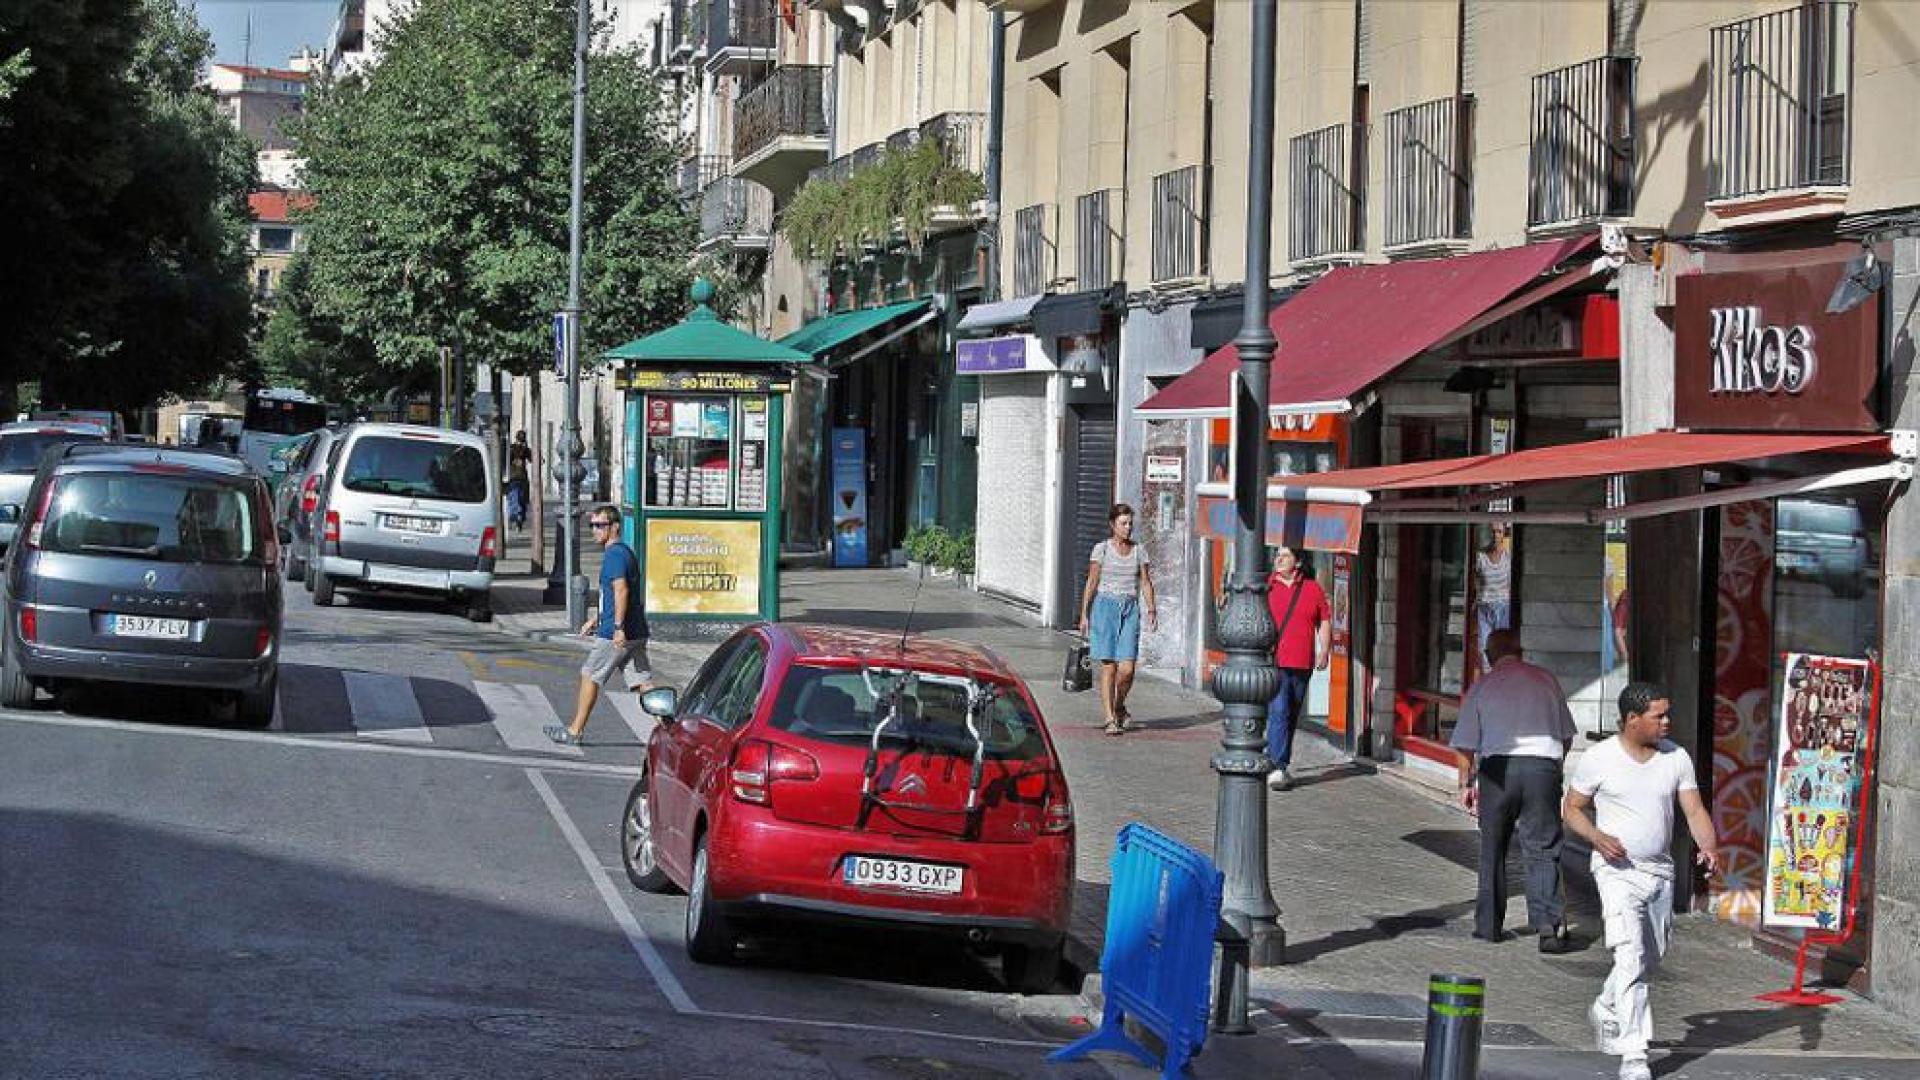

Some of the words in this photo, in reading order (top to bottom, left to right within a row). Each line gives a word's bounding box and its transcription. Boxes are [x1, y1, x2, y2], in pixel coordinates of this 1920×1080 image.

[158, 619, 187, 635] FLV
[857, 861, 911, 883] 0933
[918, 865, 958, 887] GXP
